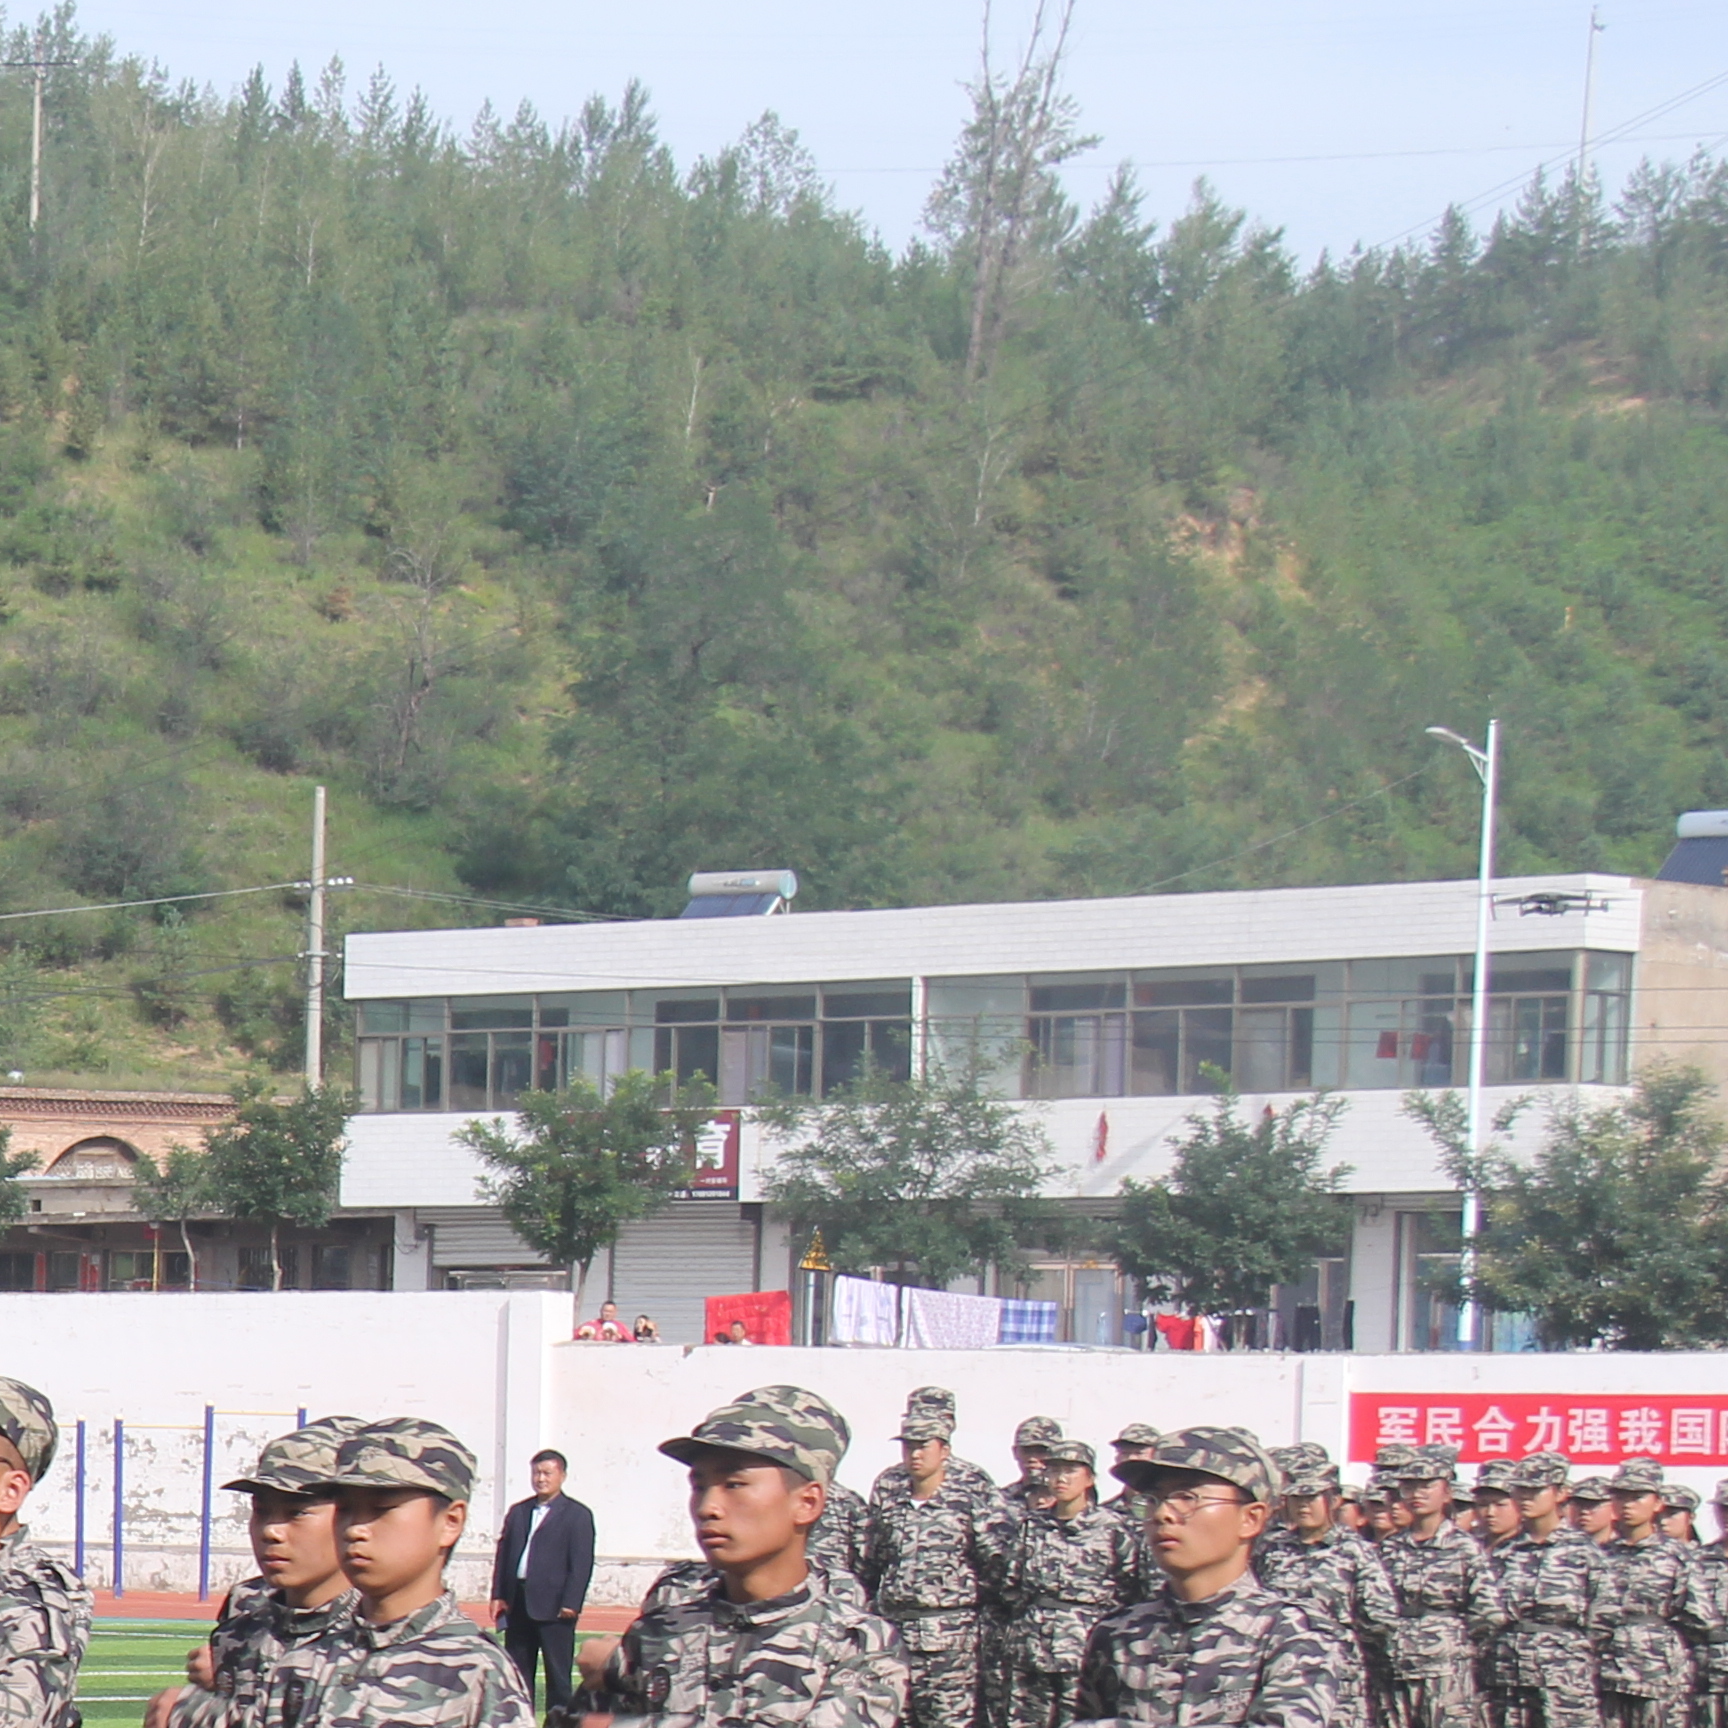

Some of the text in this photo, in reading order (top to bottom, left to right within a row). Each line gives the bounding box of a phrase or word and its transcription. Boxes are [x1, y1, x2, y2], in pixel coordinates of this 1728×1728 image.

[1376, 1406, 1728, 1455] 军民合力强我国
